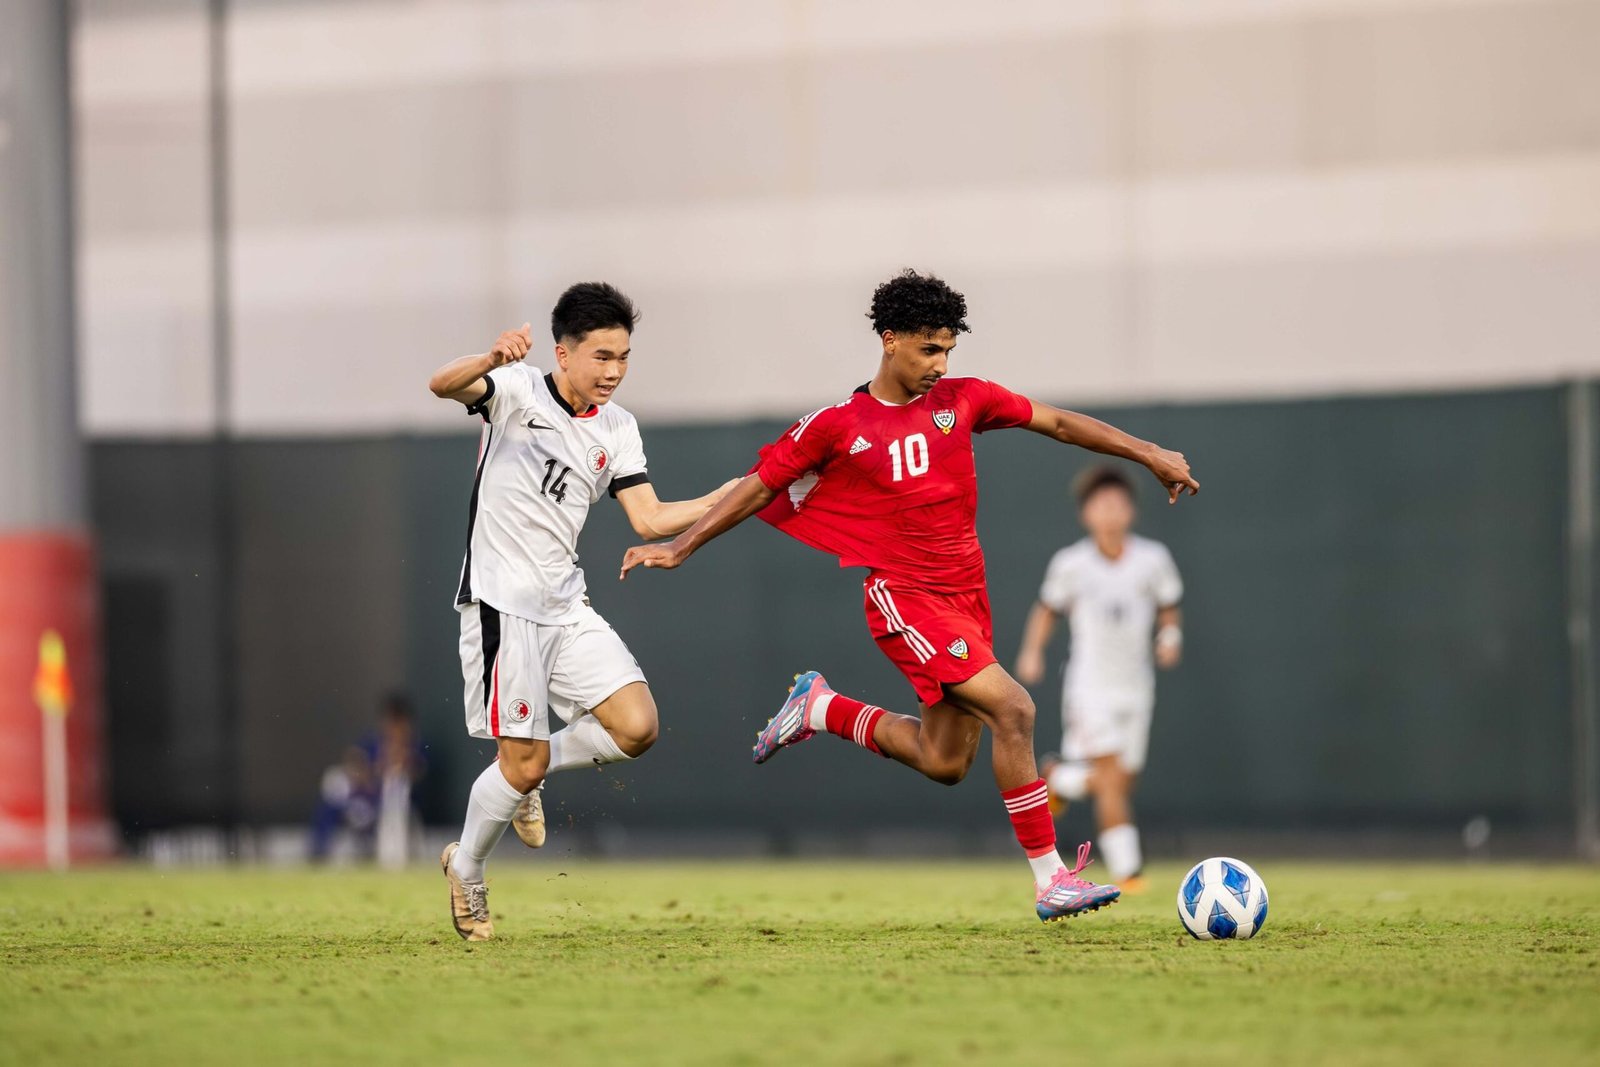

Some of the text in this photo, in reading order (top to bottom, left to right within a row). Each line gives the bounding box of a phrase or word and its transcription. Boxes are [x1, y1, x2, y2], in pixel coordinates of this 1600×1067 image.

[849, 442, 872, 454] adidas
[888, 432, 929, 482] 10
[540, 458, 573, 505] 14
